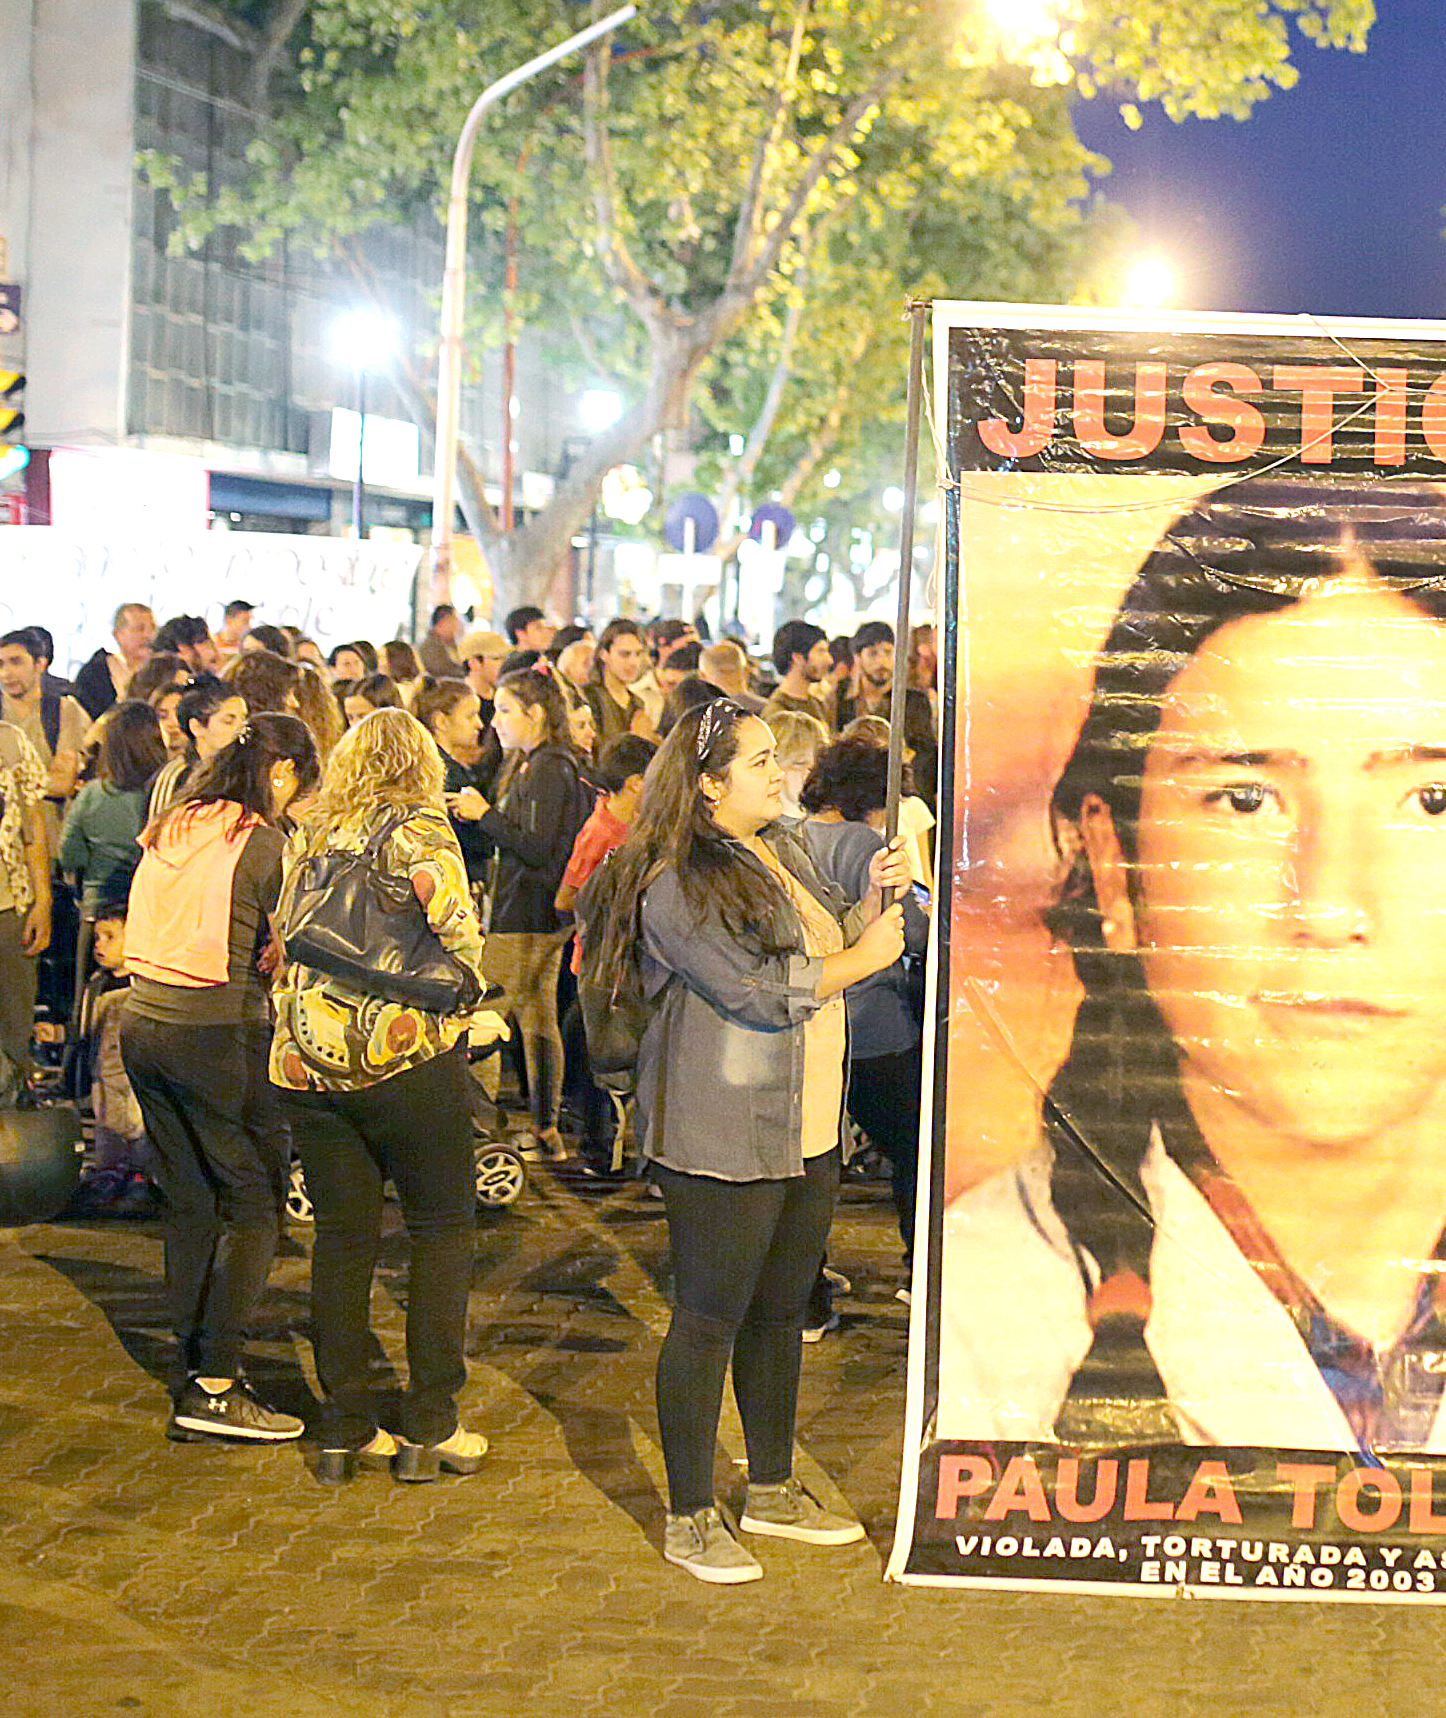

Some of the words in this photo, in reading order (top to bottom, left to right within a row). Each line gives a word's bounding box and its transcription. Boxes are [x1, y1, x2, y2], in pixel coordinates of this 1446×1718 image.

[934, 1454, 1244, 1525] PAULA
[955, 1534, 1129, 1563] VIOLADA,
[1140, 1535, 1367, 1567] TORTURADA
[1379, 1547, 1403, 1568] Y
[1140, 1560, 1187, 1583] EN
[1200, 1561, 1244, 1584] EL
[1255, 1562, 1335, 1588] AÑO
[1346, 1568, 1436, 1593] 2003
